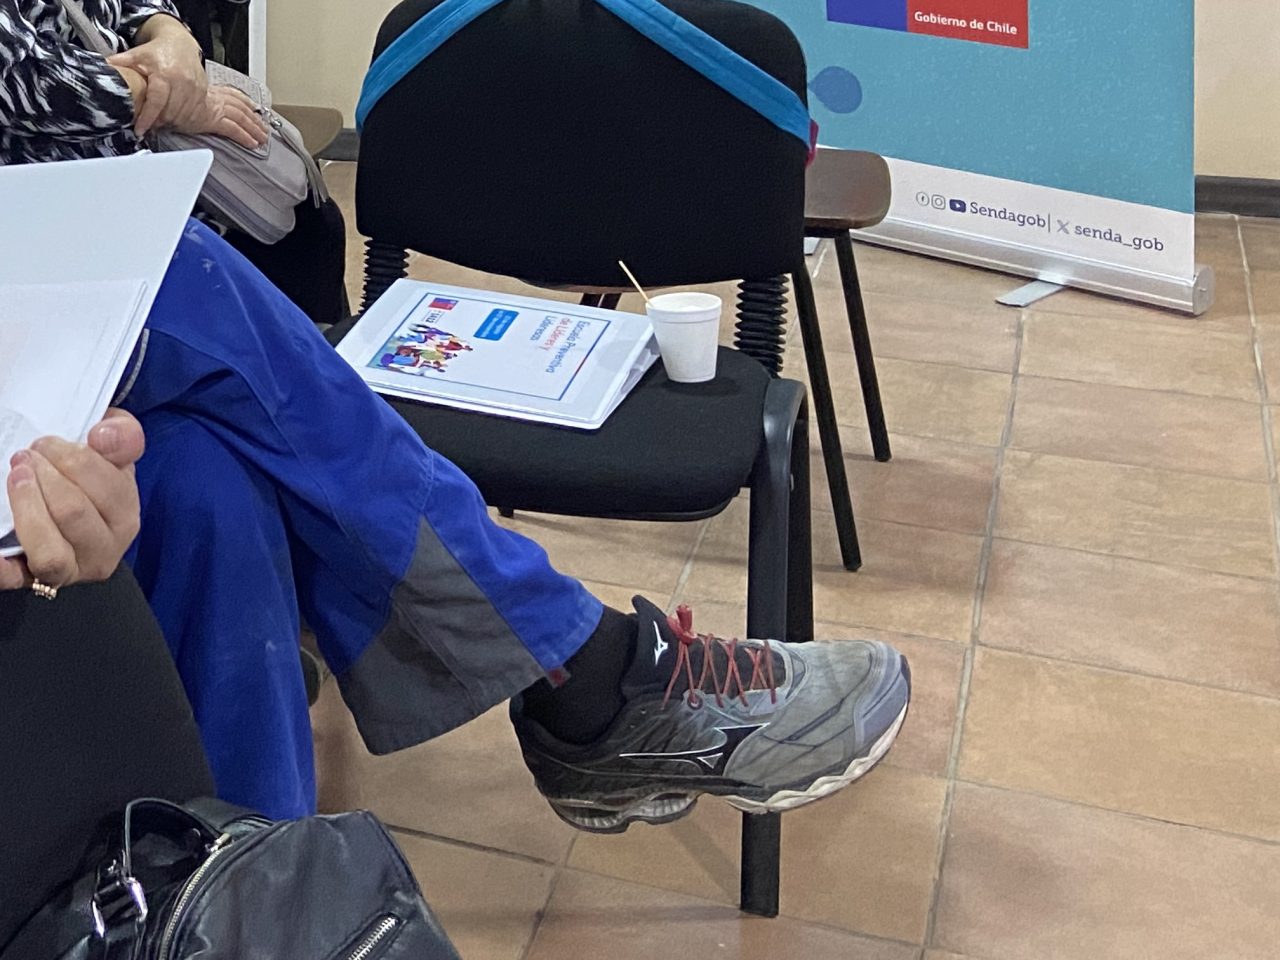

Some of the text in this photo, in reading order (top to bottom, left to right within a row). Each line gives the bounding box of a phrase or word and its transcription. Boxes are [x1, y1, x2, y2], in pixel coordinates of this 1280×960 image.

[914, 11, 1018, 35] Gobierno de Chile
[970, 202, 1046, 228] Sendagob
[1074, 224, 1165, 252] senda_gob
